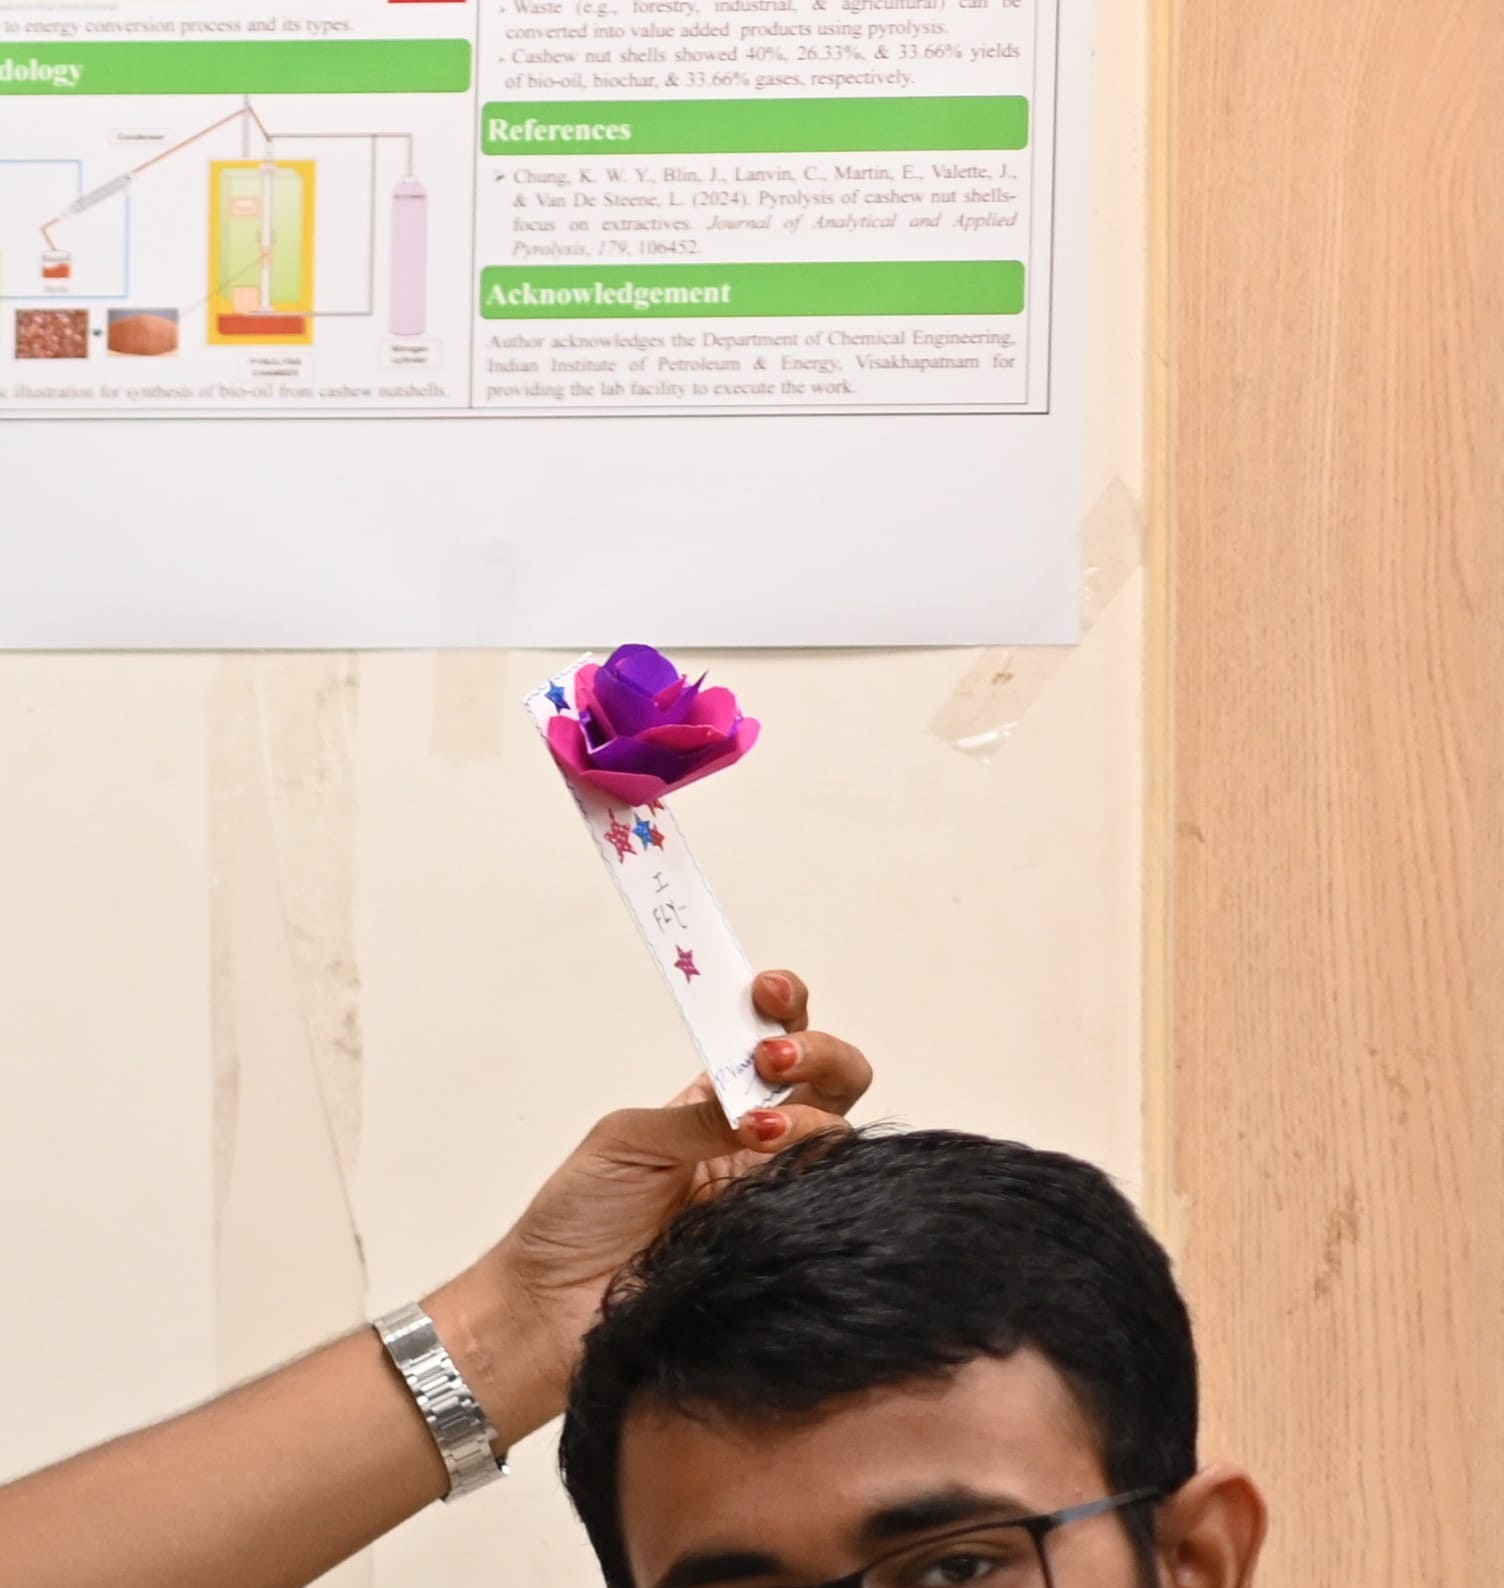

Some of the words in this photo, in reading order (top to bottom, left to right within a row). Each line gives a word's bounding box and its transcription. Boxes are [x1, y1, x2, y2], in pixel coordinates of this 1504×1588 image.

[505, 24, 589, 39] converted
[592, 23, 626, 38] into
[630, 23, 675, 38] value
[679, 22, 731, 37] added
[738, 21, 814, 40] products
[814, 20, 863, 39] using
[867, 19, 949, 38] pyrolysis.
[511, 49, 578, 64] Cashew
[584, 48, 612, 63] nut
[618, 48, 667, 63] shells
[673, 47, 739, 62] showed
[874, 45, 889, 60] &
[969, 43, 1020, 62] yields
[505, 74, 524, 89] of
[524, 73, 588, 92] bio-oil,
[590, 73, 659, 92] biochar,
[664, 72, 680, 87] &
[686, 72, 750, 87] 33.66%
[754, 75, 805, 90] gases,
[810, 70, 915, 89] respectively.
[487, 118, 632, 142] References
[487, 282, 730, 309] Acknowledgement
[488, 333, 545, 348] Author
[550, 332, 666, 351] acknowledges
[670, 332, 698, 347] the
[701, 331, 799, 350] Department
[804, 331, 825, 346] of
[825, 330, 906, 345] Chemical
[912, 330, 1015, 349] Engineering,
[487, 358, 539, 373] Indian
[549, 357, 618, 372] Institute
[627, 357, 649, 372] of
[656, 356, 742, 371] Petroleum
[752, 355, 768, 370] &
[778, 355, 843, 374] Energy,
[856, 354, 980, 373] Visakhapatnam
[992, 353, 1015, 368] for
